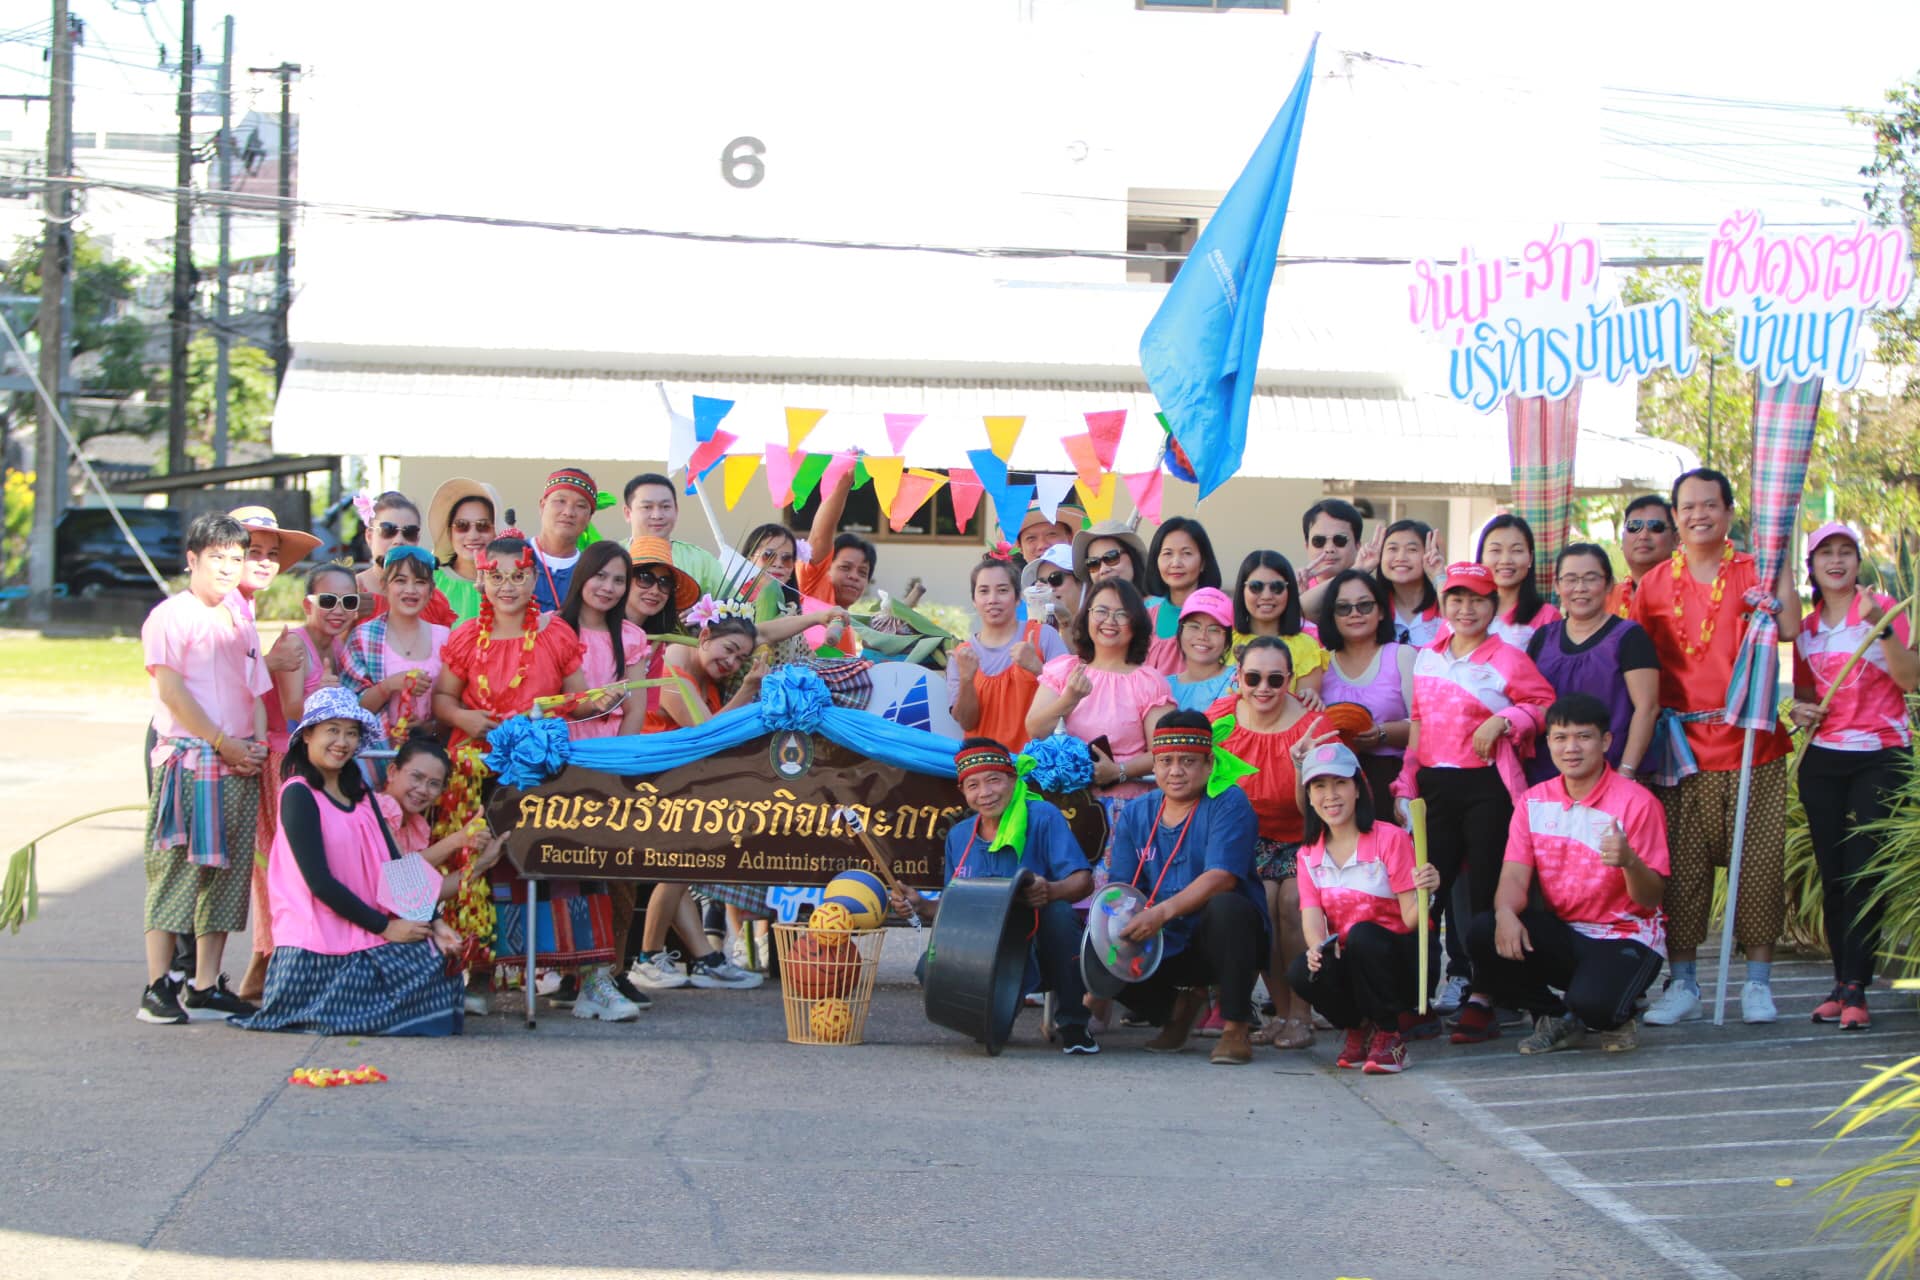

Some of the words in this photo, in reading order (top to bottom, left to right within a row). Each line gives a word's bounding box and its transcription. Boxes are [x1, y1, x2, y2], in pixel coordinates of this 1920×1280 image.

[721, 136, 766, 189] 6
[1740, 296, 1858, 384] บ้านนา
[541, 845, 608, 868] Faculty
[615, 847, 635, 866] of
[644, 848, 726, 868] Business
[893, 856, 929, 874] and
